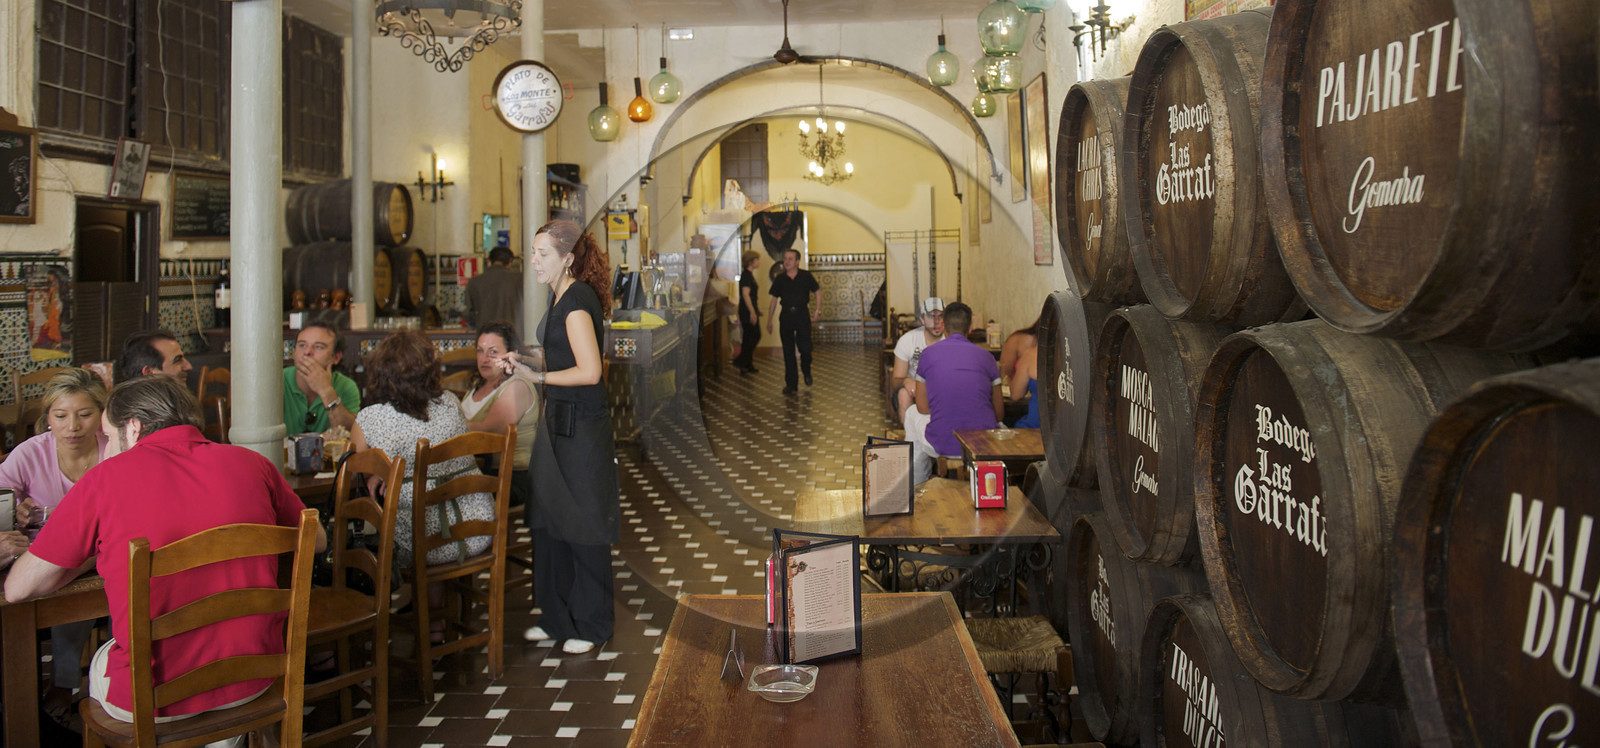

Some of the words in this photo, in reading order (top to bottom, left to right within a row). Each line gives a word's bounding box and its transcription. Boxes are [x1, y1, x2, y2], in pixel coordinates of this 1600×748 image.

[505, 69, 531, 91] PLATO
[536, 72, 550, 84] DE
[520, 88, 551, 99] MONTE
[1316, 17, 1464, 128] PAJARETE
[507, 101, 556, 126] Garrafas
[1167, 102, 1212, 140] Bodega
[1169, 141, 1190, 170] Las
[1156, 153, 1215, 206] Garraf
[1342, 156, 1426, 234] Gomara
[1120, 364, 1156, 413] MOSCA
[1256, 447, 1292, 492] Las
[1501, 492, 1600, 604] MAL
